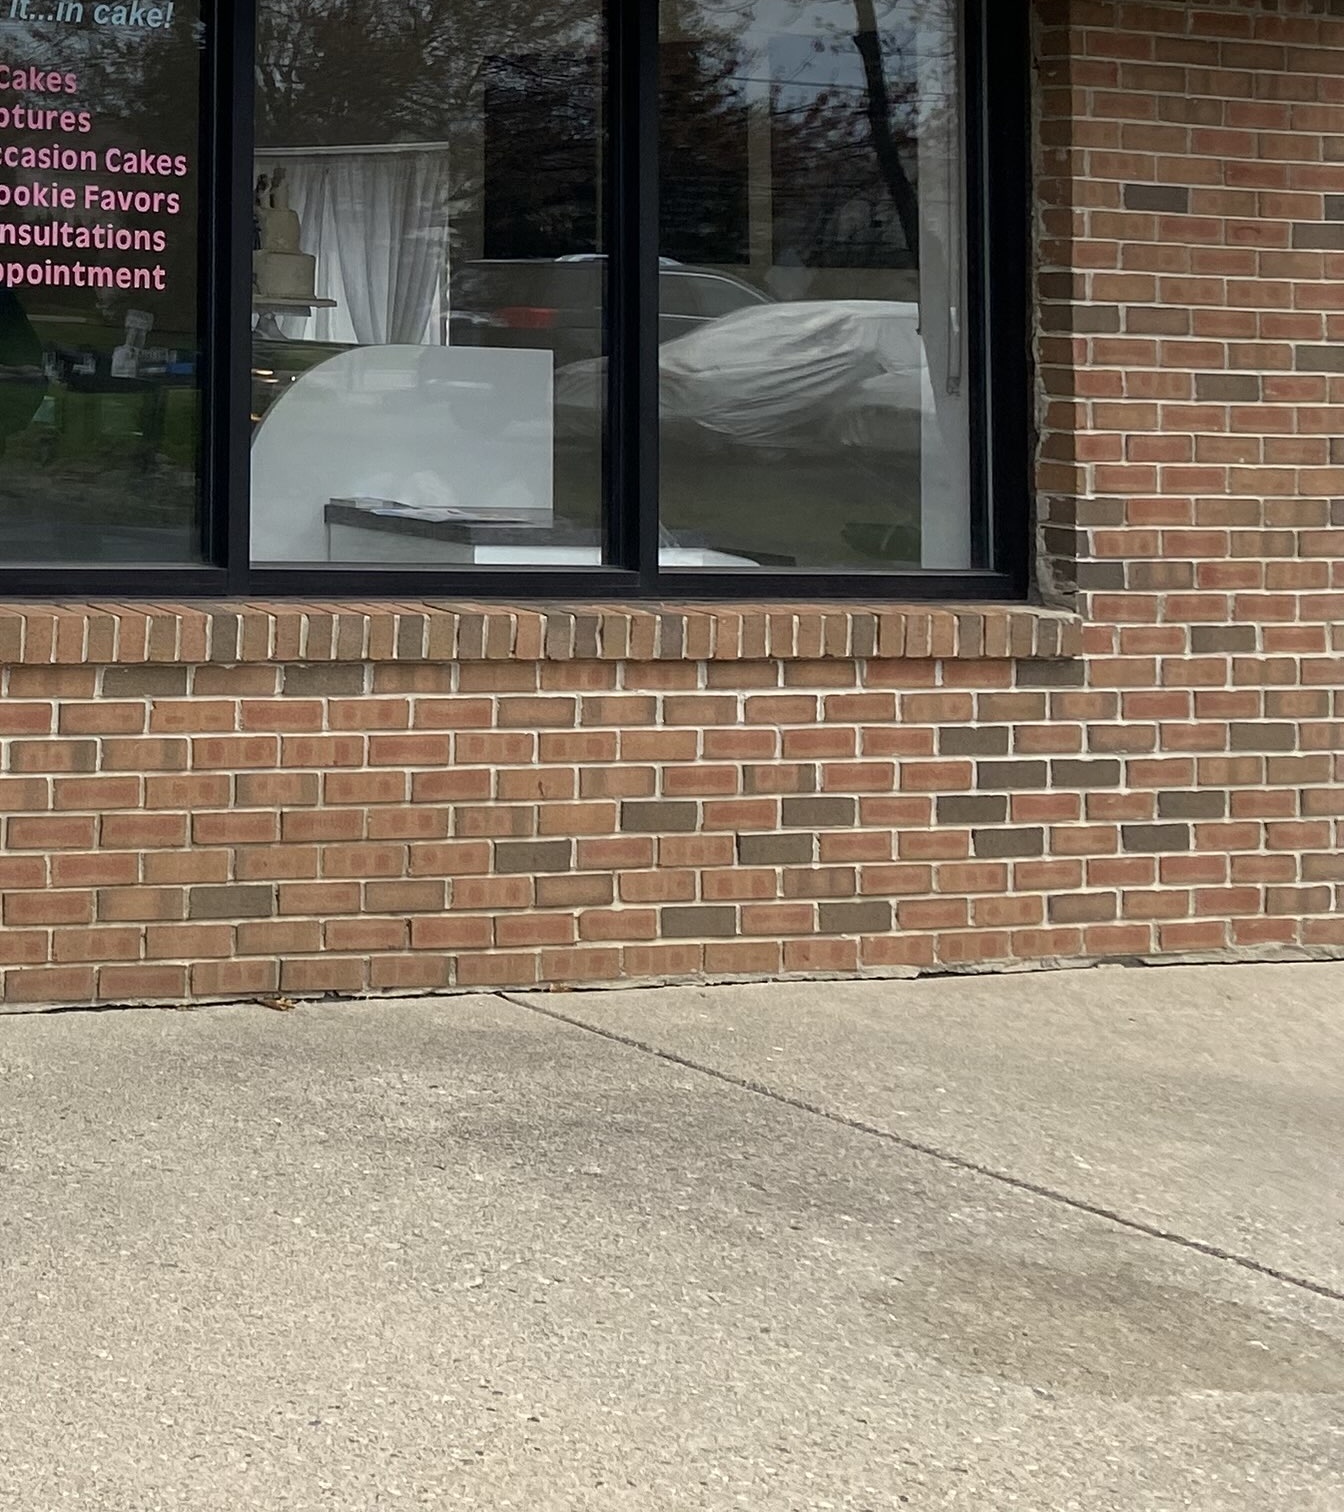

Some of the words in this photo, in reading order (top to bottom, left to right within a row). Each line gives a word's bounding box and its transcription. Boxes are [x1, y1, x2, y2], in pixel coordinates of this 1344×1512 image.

[93, 0, 175, 29] cake!
[105, 147, 187, 176] Cakes
[84, 184, 180, 215] Favors
